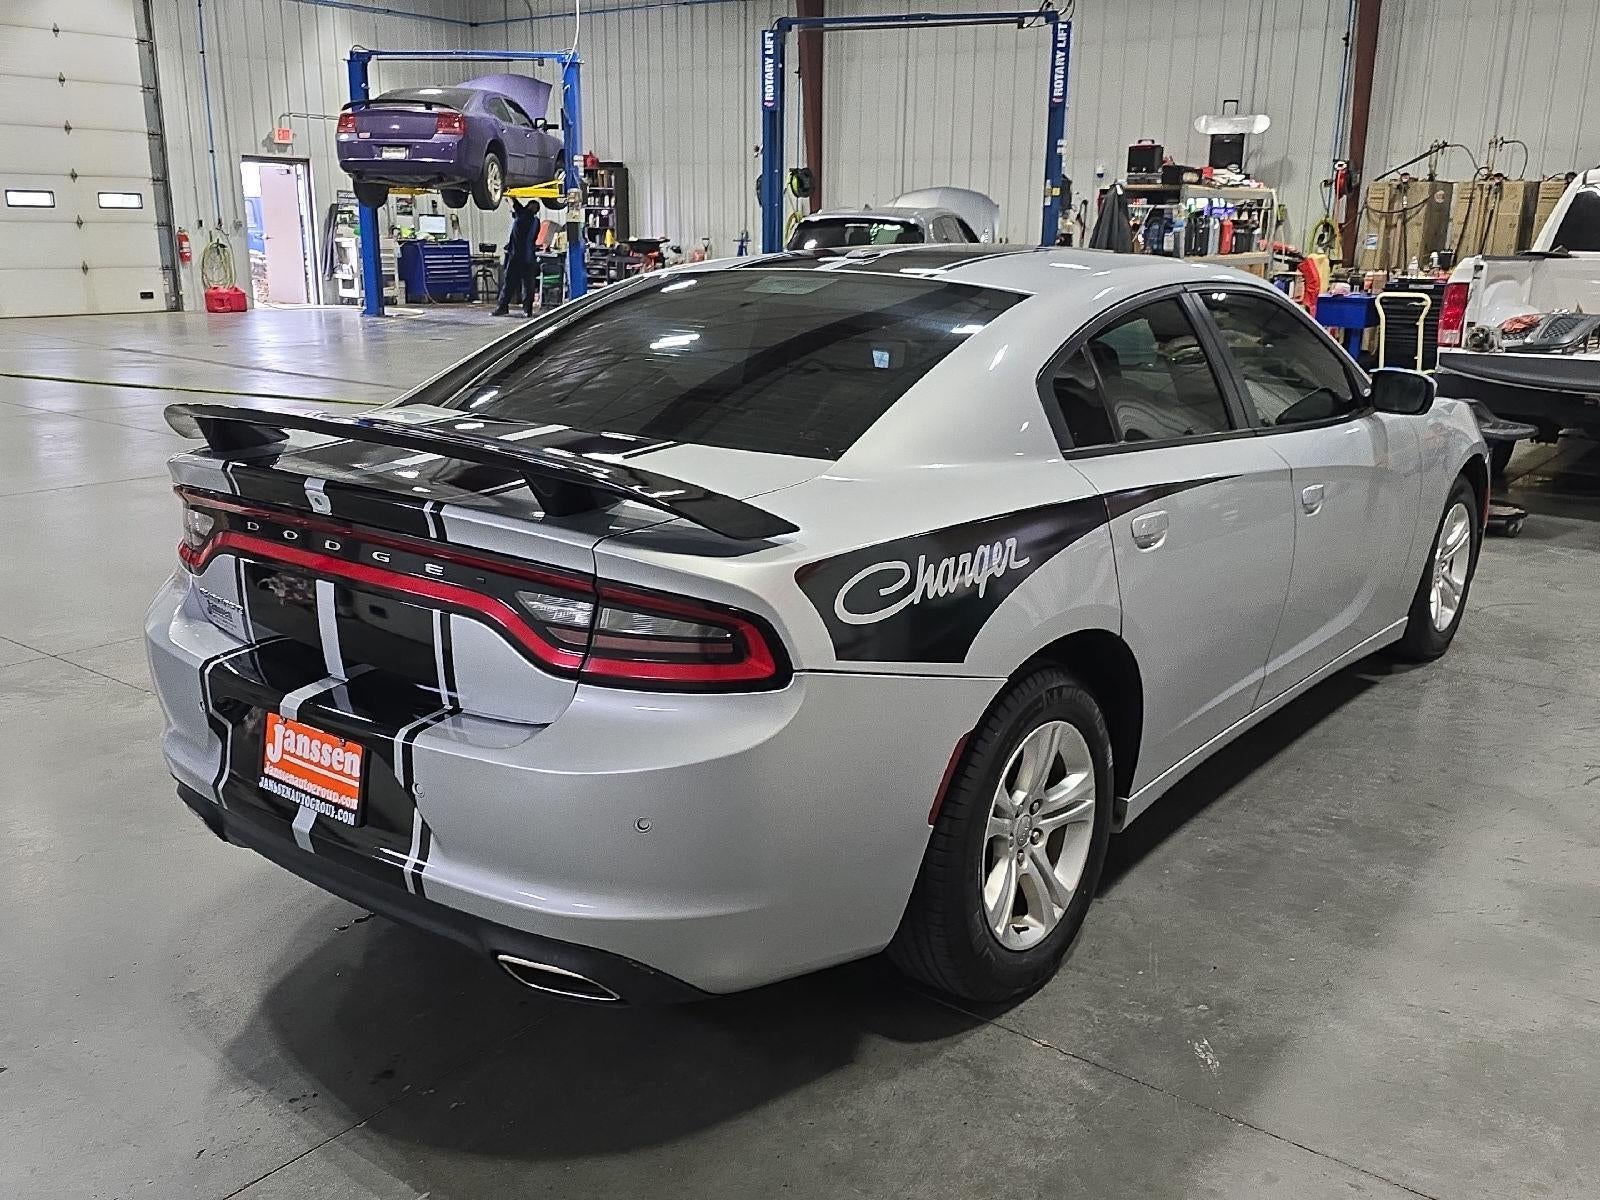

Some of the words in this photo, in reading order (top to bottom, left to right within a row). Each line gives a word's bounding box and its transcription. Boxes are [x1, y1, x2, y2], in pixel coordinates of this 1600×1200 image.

[764, 31, 774, 55] LIFT
[1057, 23, 1068, 48] LIFT
[764, 57, 774, 101] ROTARY
[1053, 50, 1066, 97] ROTARY
[246, 521, 444, 576] DODGE
[834, 537, 1030, 625] Charger
